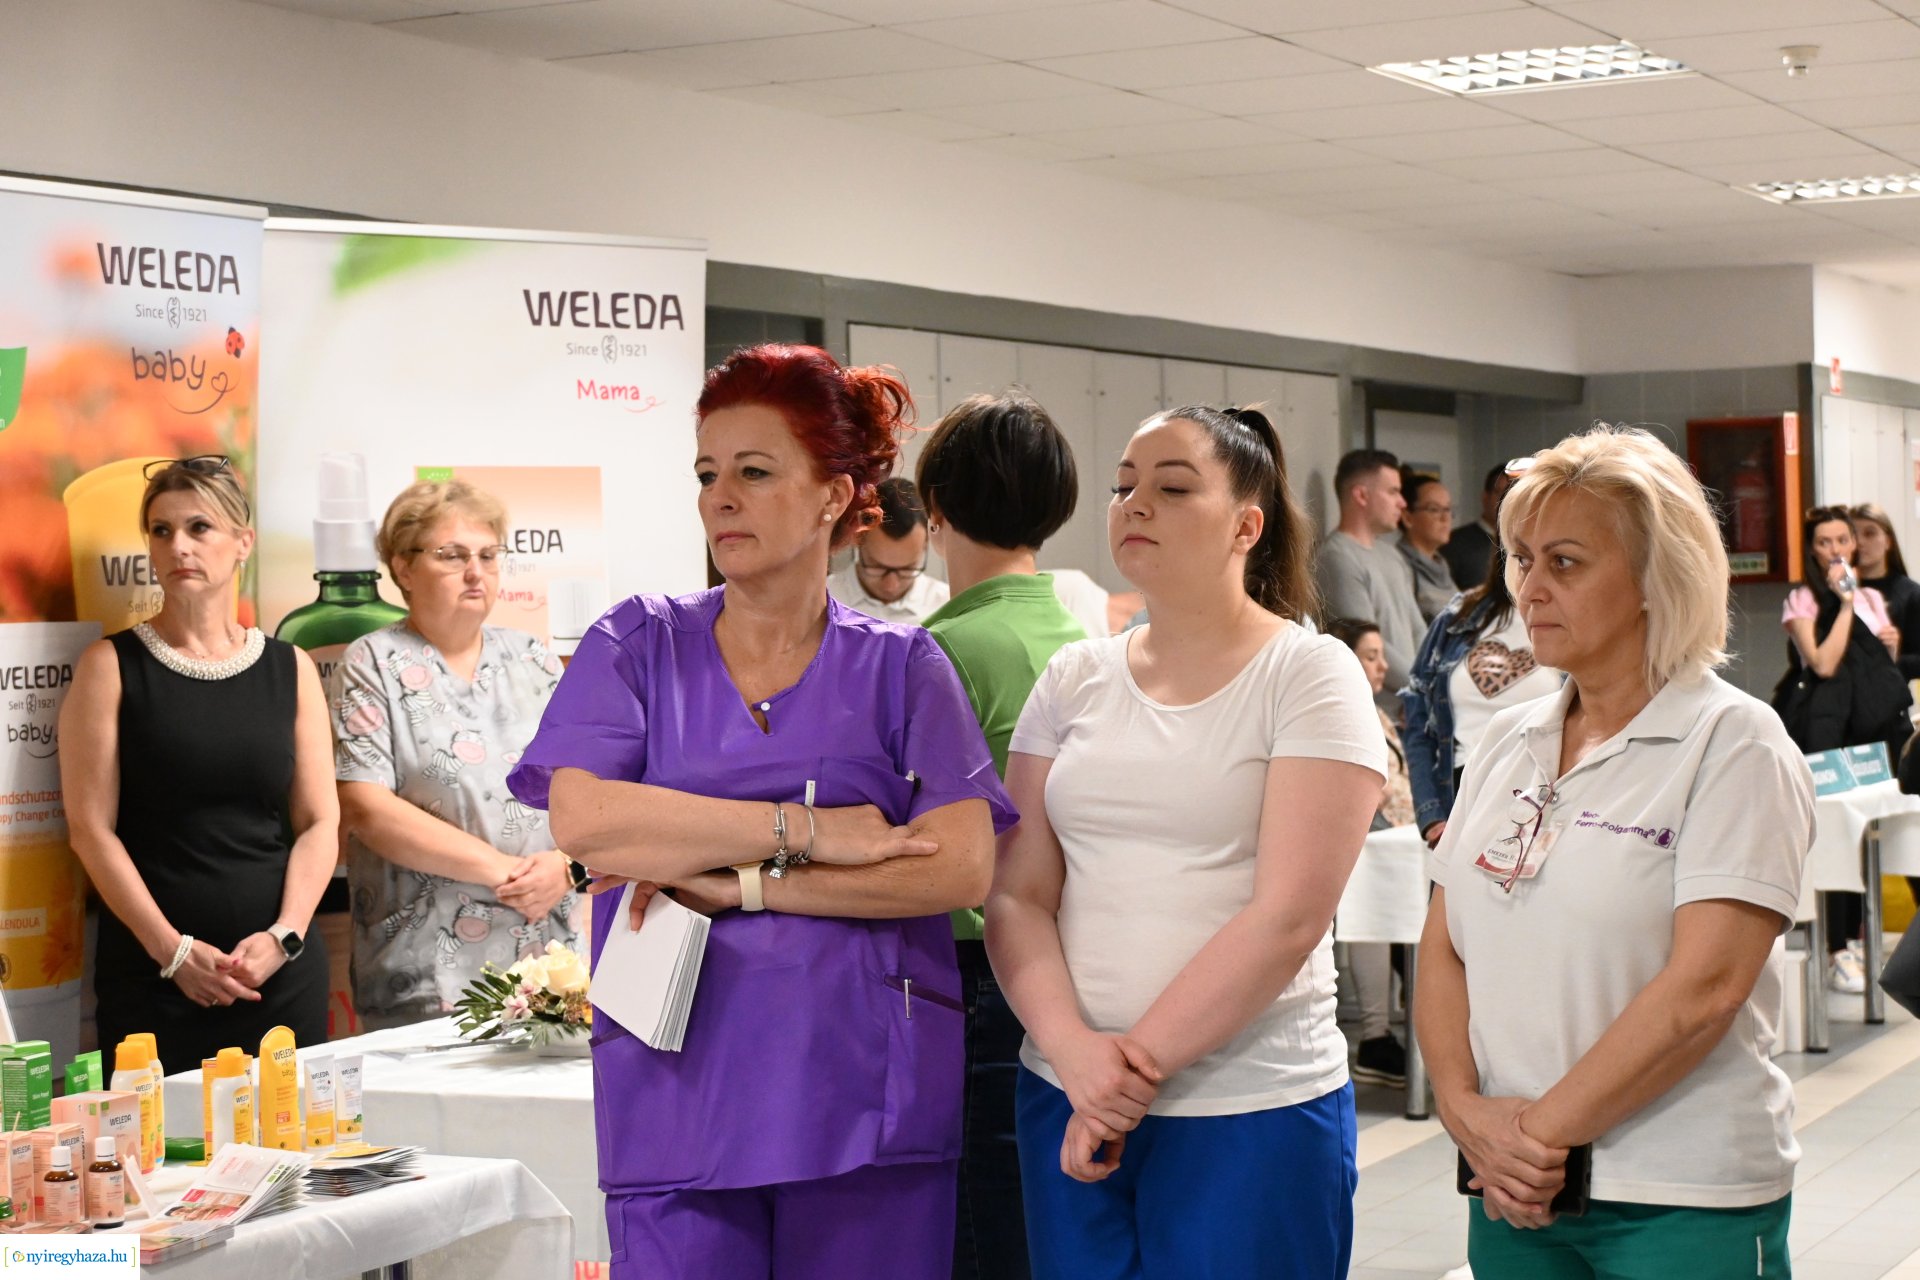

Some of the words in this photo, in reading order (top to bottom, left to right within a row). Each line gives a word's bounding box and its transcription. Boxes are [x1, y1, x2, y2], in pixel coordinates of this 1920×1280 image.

[96, 242, 241, 296] WELEDA
[135, 304, 165, 320] Since
[182, 307, 208, 322] 1921
[522, 288, 685, 331] WELEDA
[566, 342, 599, 356] Since
[620, 344, 648, 357] 1921
[131, 346, 207, 390] baby
[576, 378, 641, 401] Mama
[7, 721, 54, 745] baby
[15, 810, 49, 823] Change
[109, 1114, 132, 1127] WELEDA
